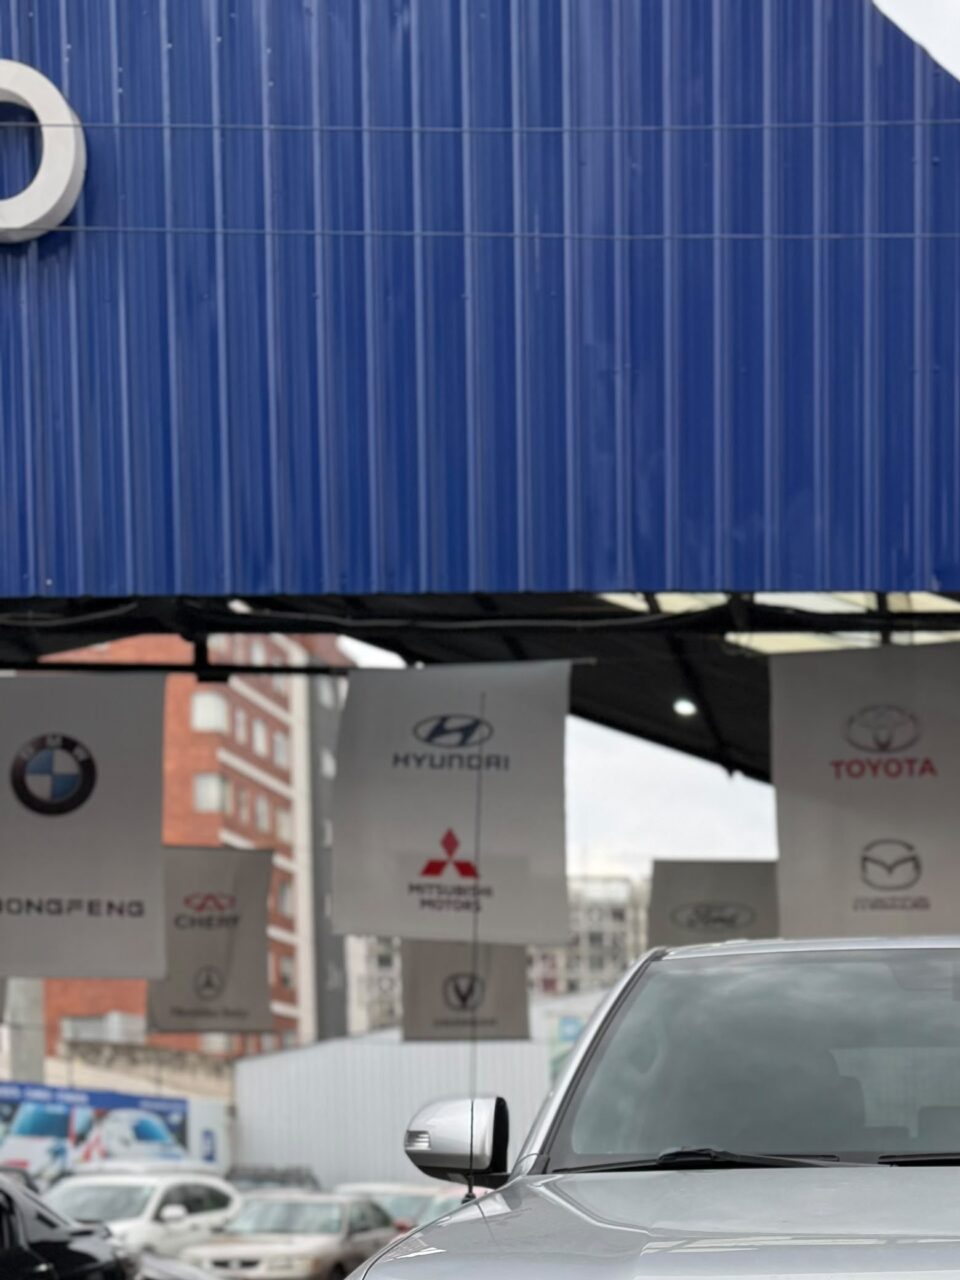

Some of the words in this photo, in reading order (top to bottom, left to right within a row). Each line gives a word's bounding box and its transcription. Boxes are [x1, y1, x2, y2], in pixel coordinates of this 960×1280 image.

[392, 752, 510, 770] HYUNDAI
[829, 757, 938, 780] TOYOTA
[0, 897, 146, 919] ONGFENG
[419, 898, 483, 912] MOTORS
[173, 912, 241, 931] CHERY
